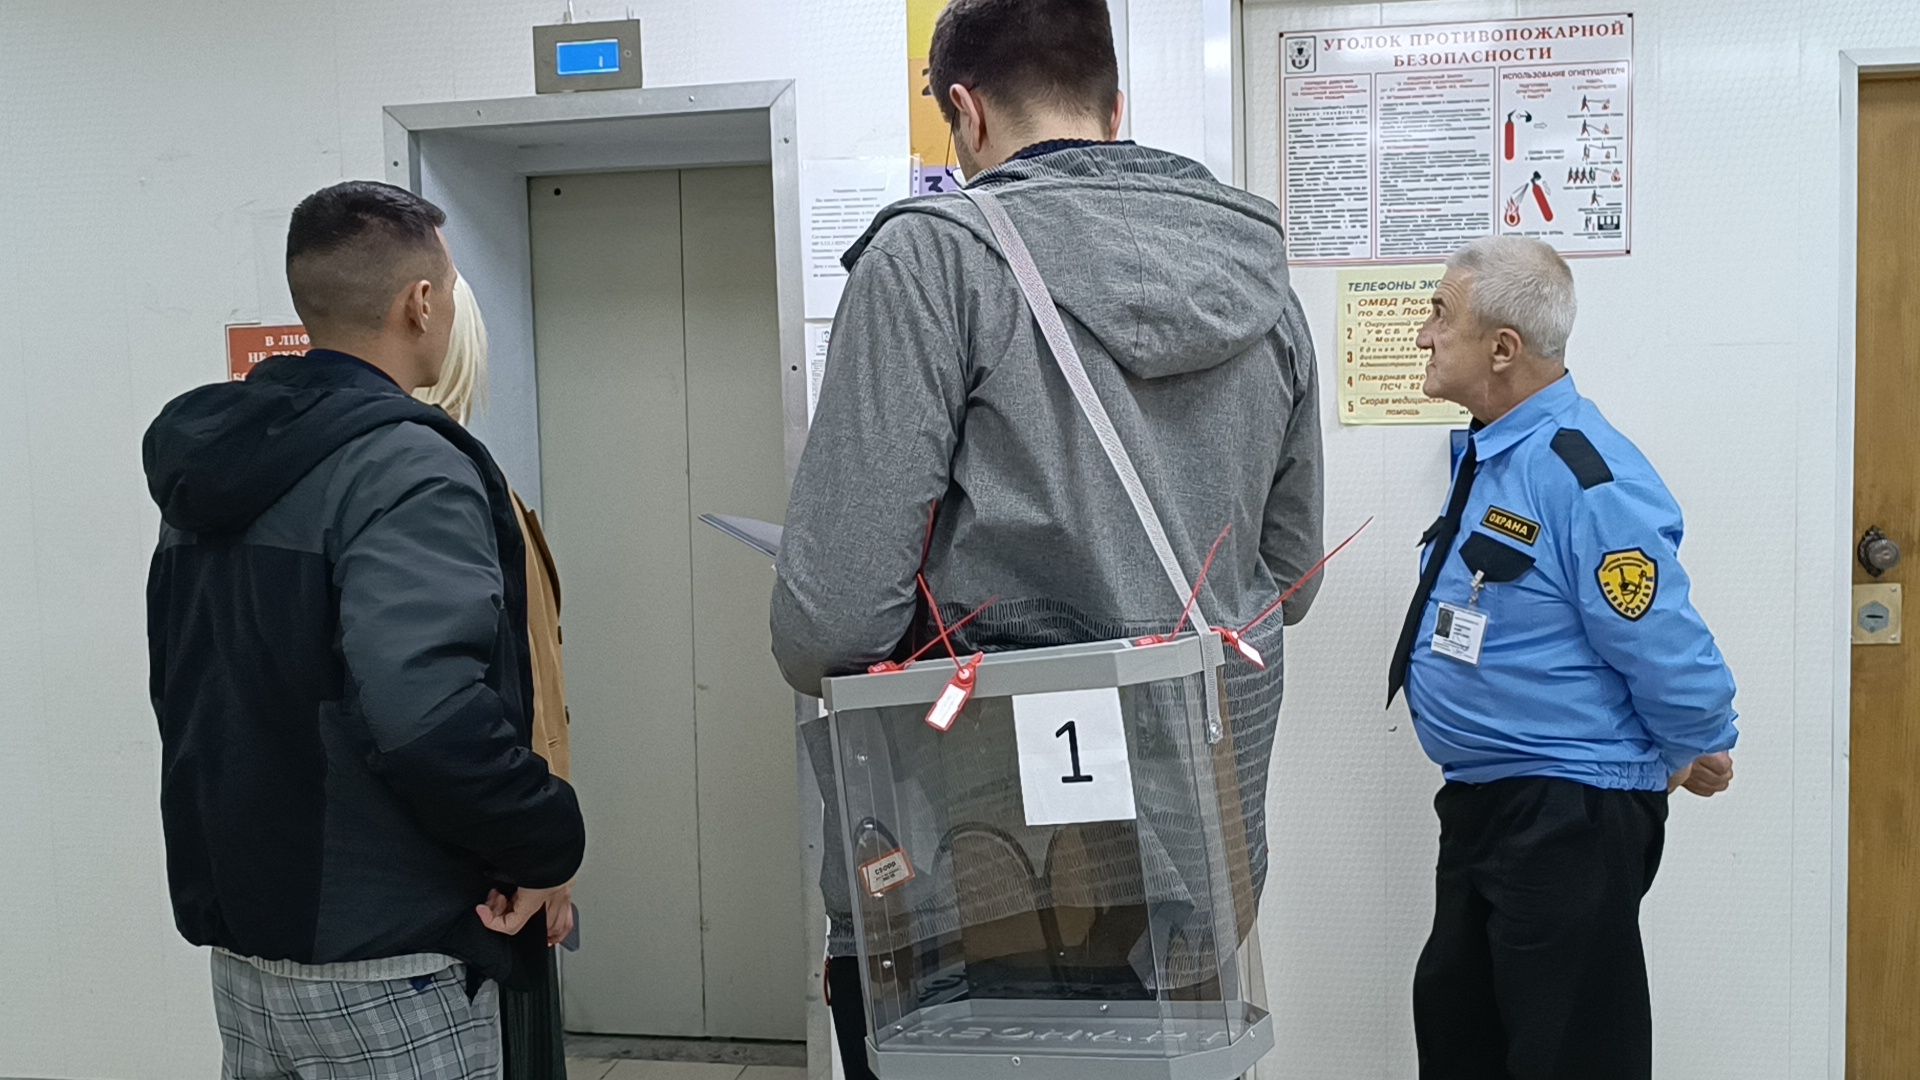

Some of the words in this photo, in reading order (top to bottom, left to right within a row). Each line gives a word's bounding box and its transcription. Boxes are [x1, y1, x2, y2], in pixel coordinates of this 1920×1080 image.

[1324, 35, 1402, 51] УГОЛОК
[1410, 21, 1624, 46] ПРОТИВОПОЖАРНОЙ
[1394, 47, 1551, 67] БЕЗОПАСНОСТИ
[1348, 281, 1415, 292] ТЕЛЕФОНЫ
[1347, 303, 1352, 315] 1
[1358, 298, 1398, 308] ОМВД
[1347, 328, 1353, 340] 2
[265, 336, 275, 347] В
[1347, 351, 1353, 363] 3
[1347, 376, 1353, 388] 4
[1359, 374, 1406, 382] Пожарная
[1348, 401, 1354, 413] 5
[1360, 396, 1389, 407] Скорая
[1489, 513, 1528, 536] ОХРАНА
[1055, 720, 1093, 784] 1
